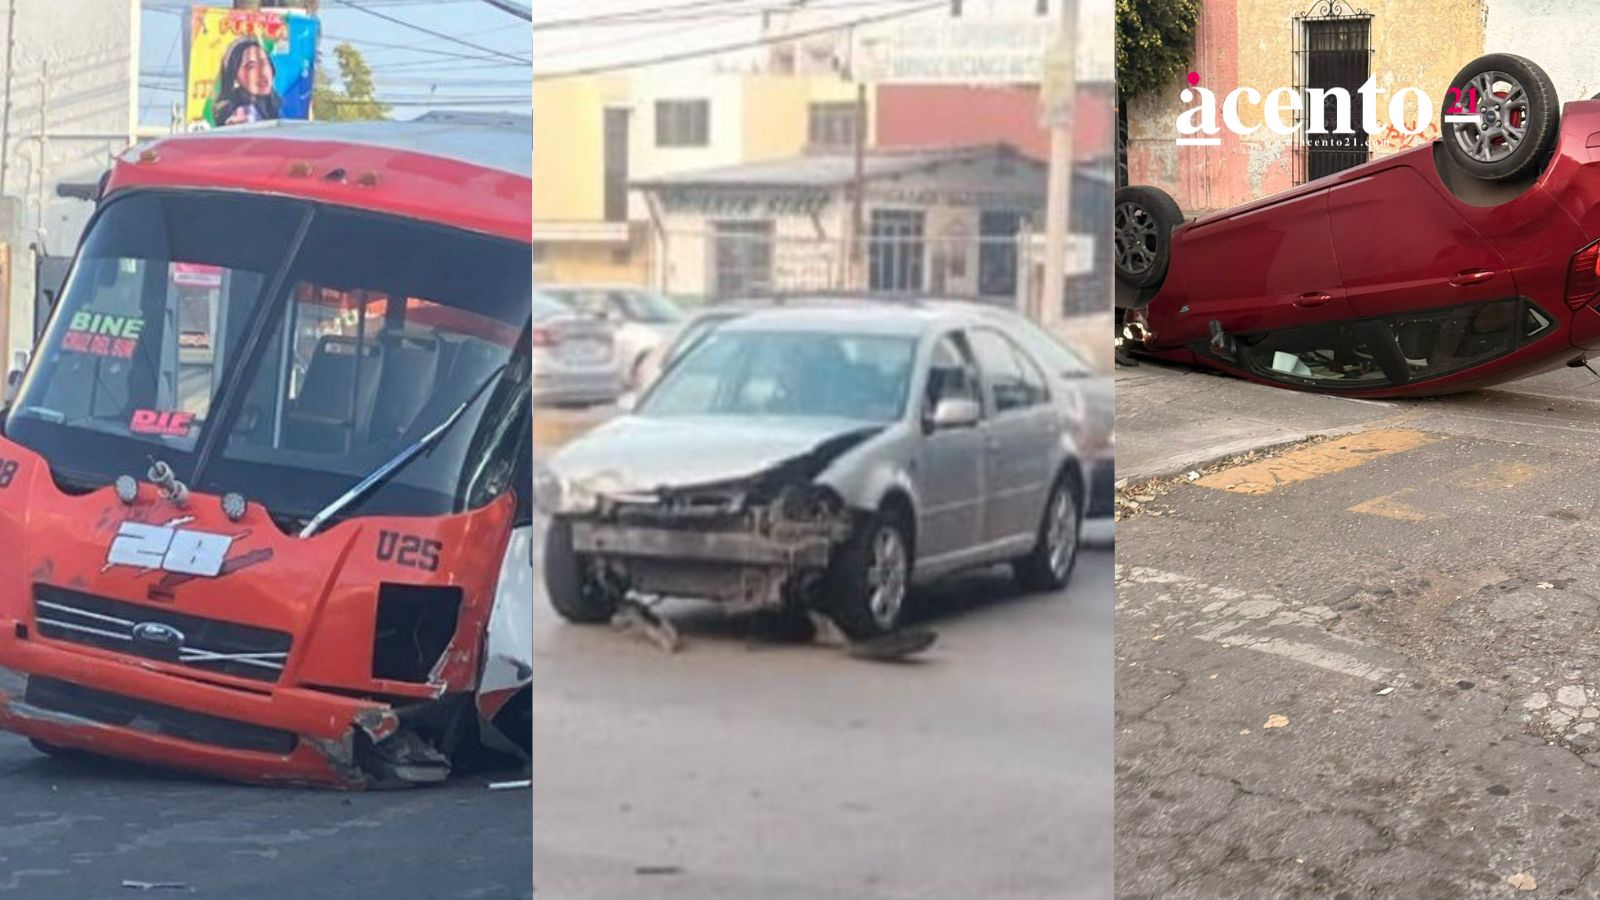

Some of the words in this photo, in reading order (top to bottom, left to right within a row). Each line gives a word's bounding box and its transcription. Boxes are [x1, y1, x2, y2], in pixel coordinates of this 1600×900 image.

[69, 311, 145, 339] BINE
[0, 458, 16, 488] 8
[108, 521, 232, 577] 28
[376, 530, 442, 571] U25
